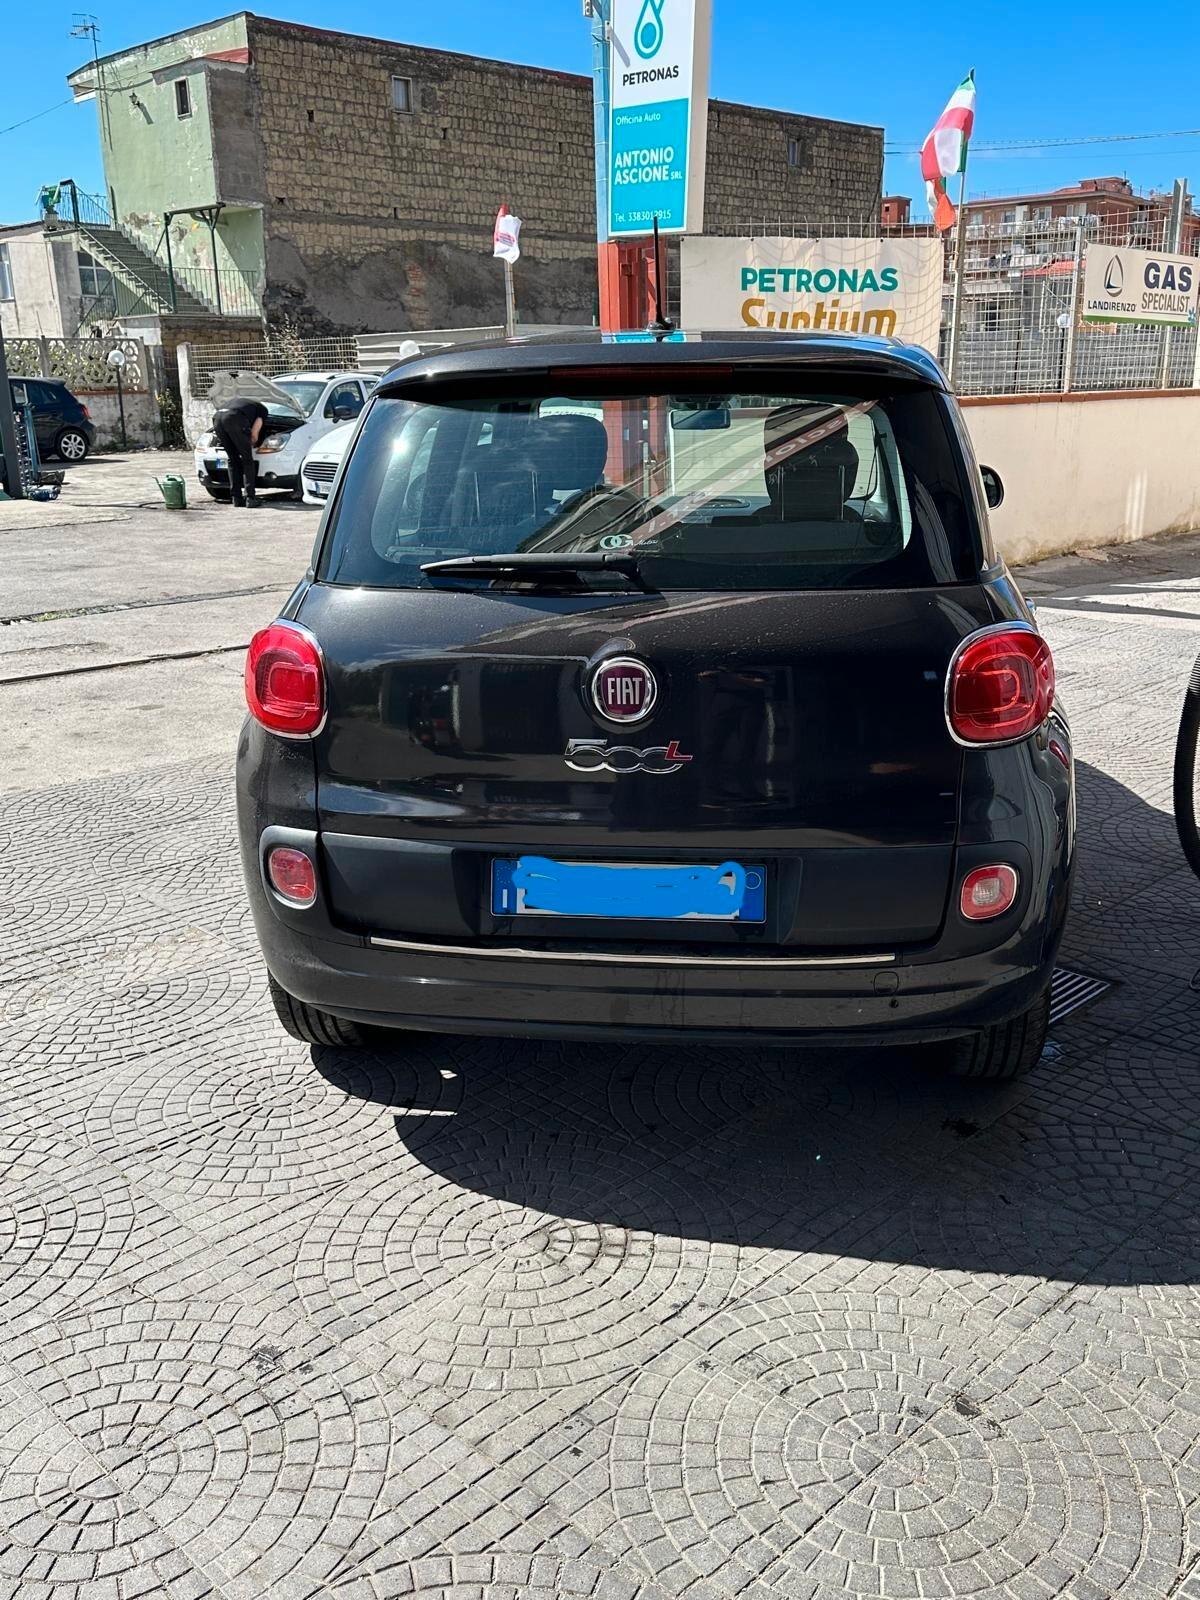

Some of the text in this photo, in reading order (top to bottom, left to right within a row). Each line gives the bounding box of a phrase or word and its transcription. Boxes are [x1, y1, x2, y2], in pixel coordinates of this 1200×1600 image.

[623, 66, 679, 86] PETRONAS
[615, 112, 661, 126] Officina Auto
[615, 146, 674, 168] ANTONIO
[614, 164, 682, 185] ASCIONE SRL
[614, 213, 626, 222] Tel.
[741, 267, 898, 293] PETRONAS
[1144, 262, 1192, 292] GAS
[1087, 300, 1136, 312] LANDIRENZO
[1141, 292, 1190, 313] SPECIALIST
[607, 677, 643, 705] FIAT
[564, 738, 694, 774] 500L
